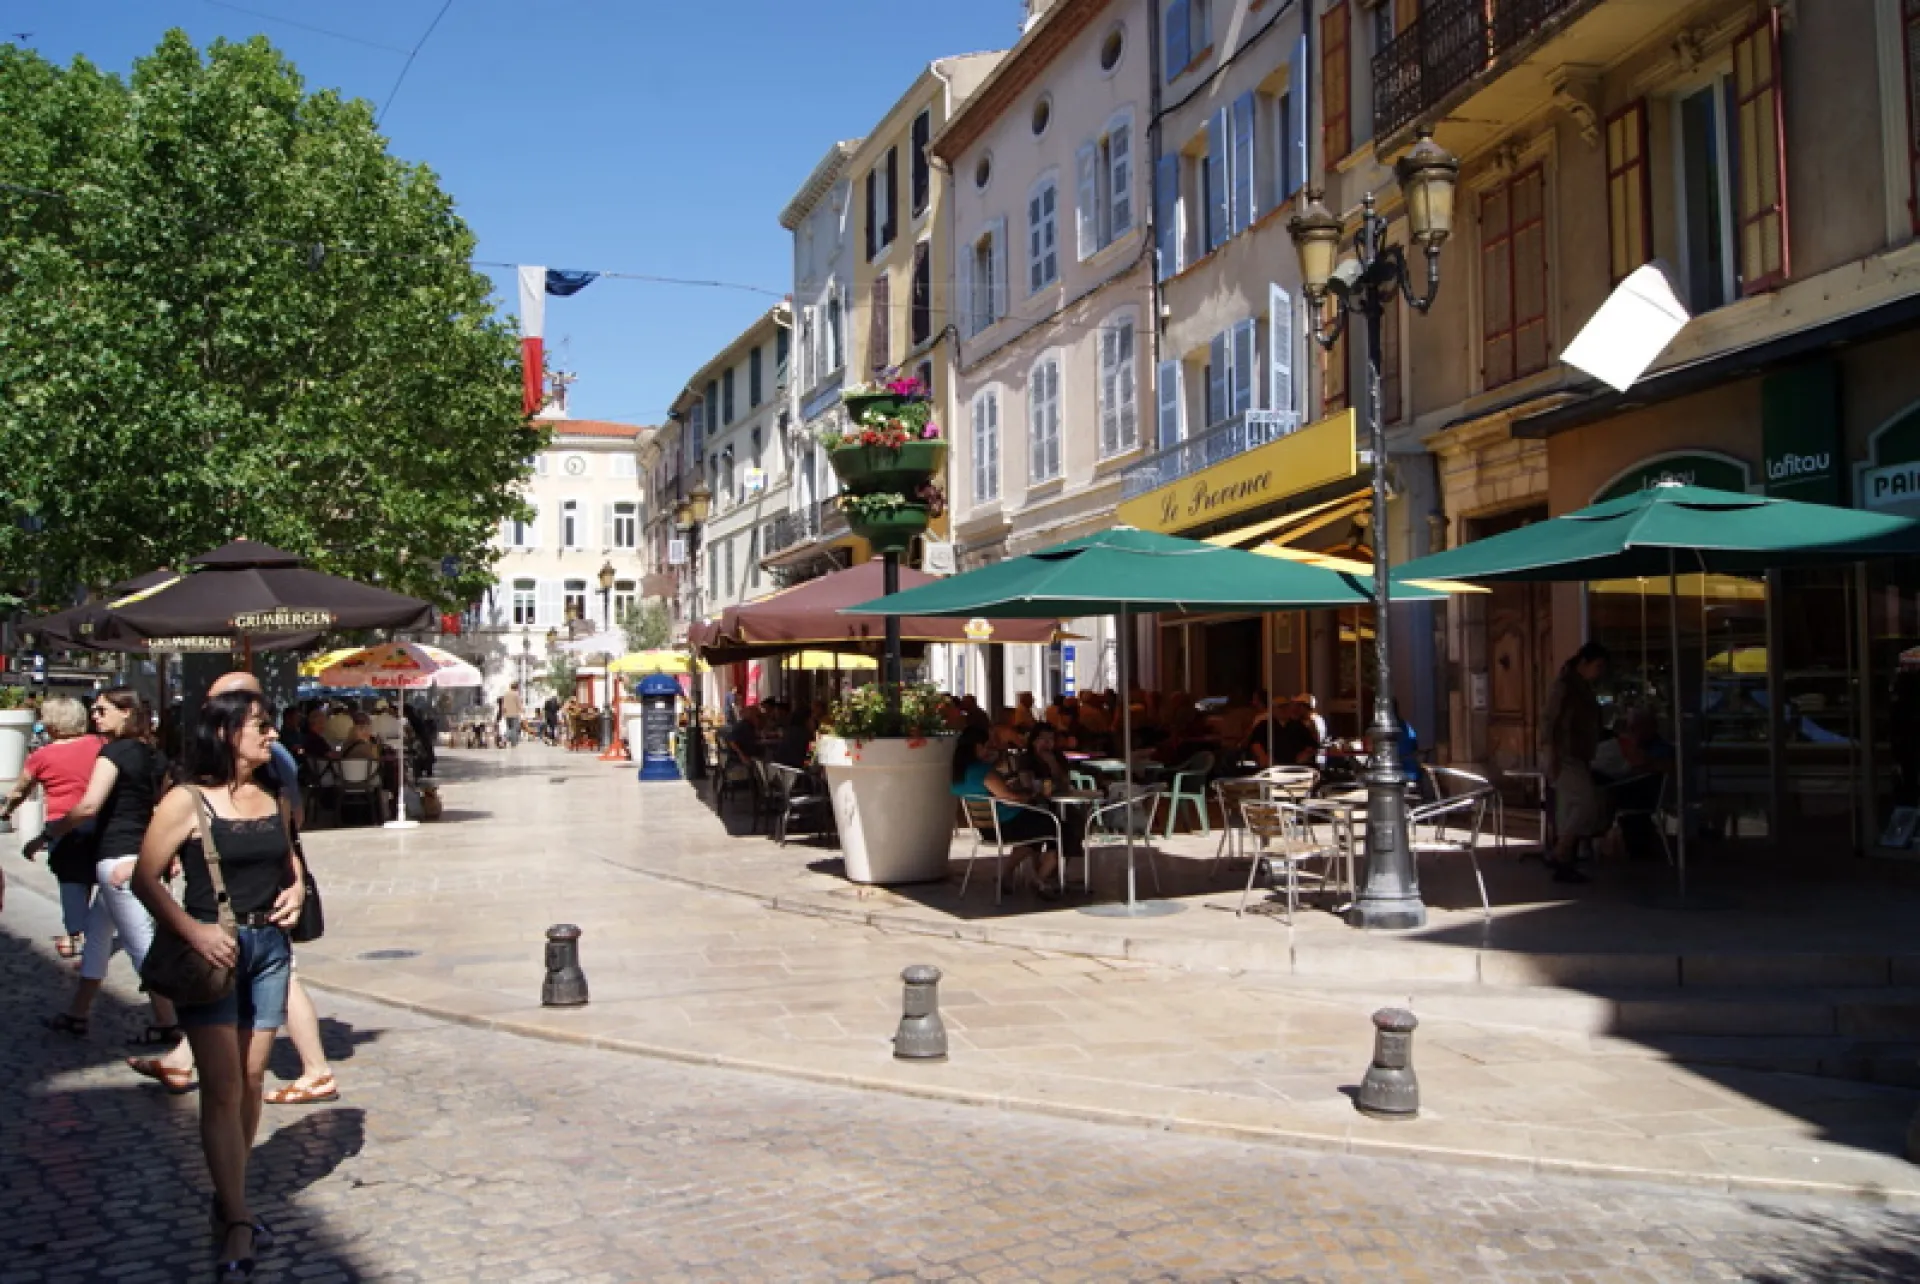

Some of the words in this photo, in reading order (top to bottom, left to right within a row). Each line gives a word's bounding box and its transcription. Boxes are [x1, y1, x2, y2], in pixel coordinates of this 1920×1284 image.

[1874, 470, 1920, 497] PAI
[1159, 490, 1179, 525] Le
[1188, 470, 1272, 516] Provence
[234, 611, 330, 627] GRIMBERGEN
